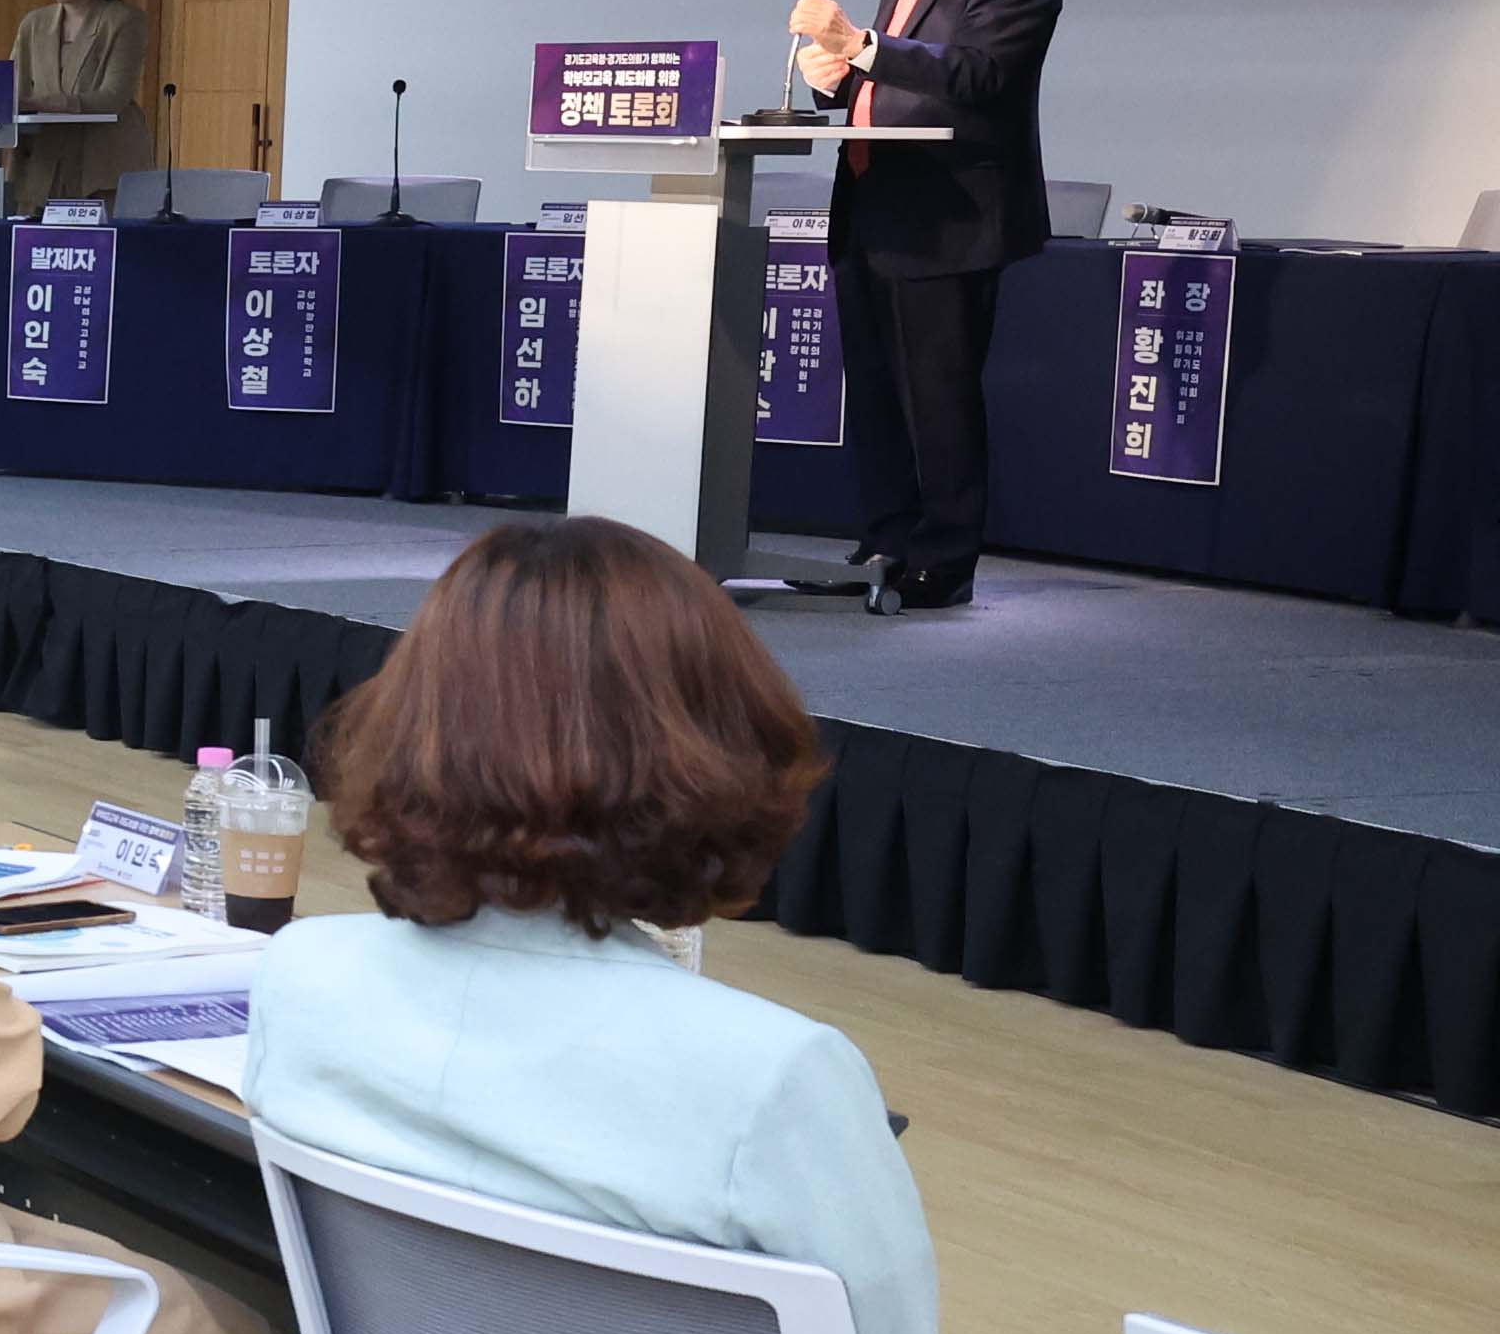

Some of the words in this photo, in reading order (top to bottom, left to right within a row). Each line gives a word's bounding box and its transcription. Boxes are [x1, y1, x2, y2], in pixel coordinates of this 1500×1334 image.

[563, 70, 612, 87] 학부모교육
[614, 70, 655, 87] 제도화를
[657, 70, 680, 87] 위한
[561, 92, 605, 127] 정책
[608, 92, 678, 127] 토론회
[792, 219, 827, 229] 이학수
[31, 247, 96, 272] 발제자
[248, 251, 320, 275] 토론자
[514, 297, 546, 409] 임선하
